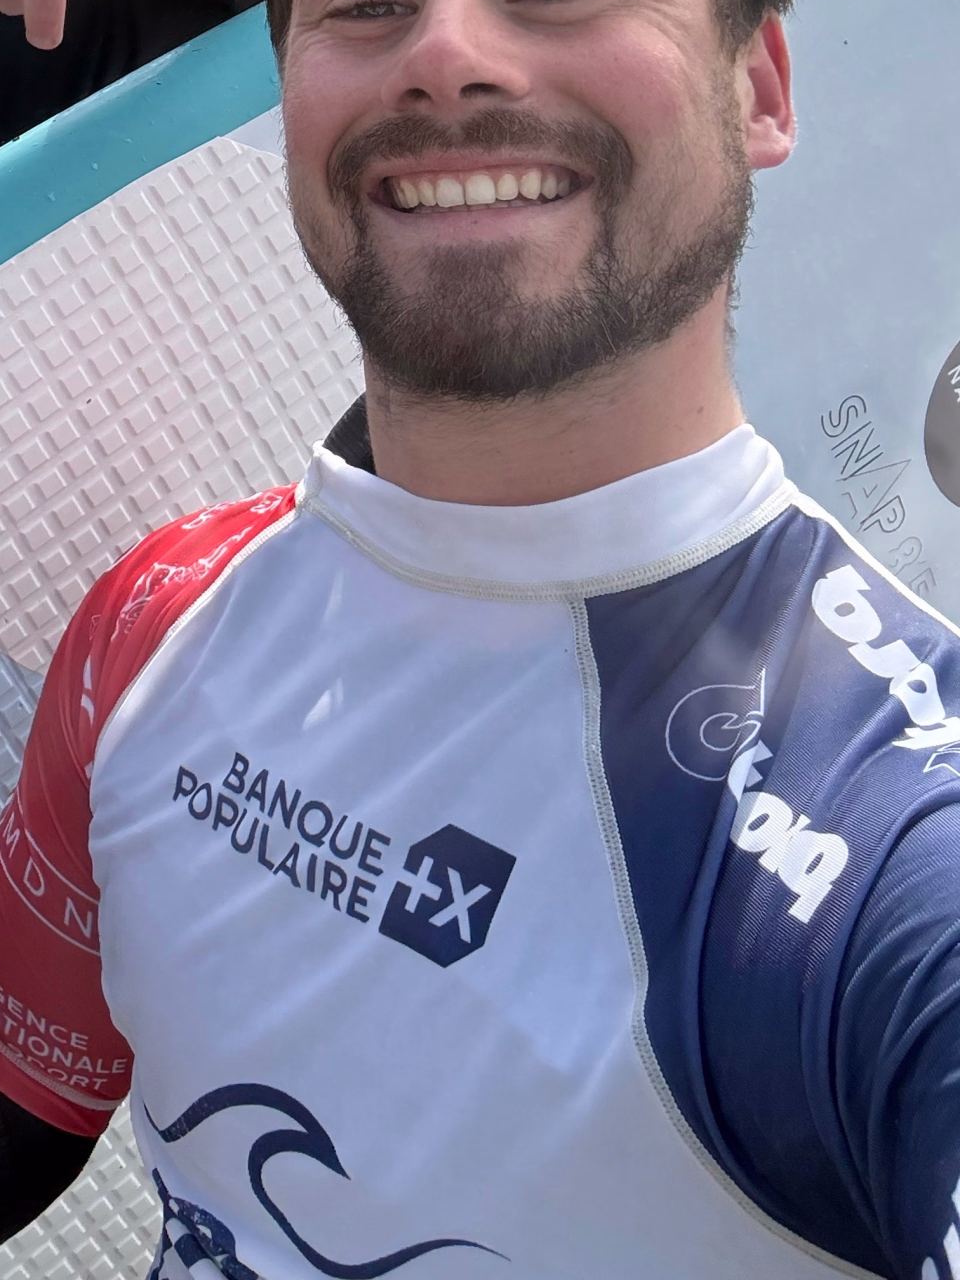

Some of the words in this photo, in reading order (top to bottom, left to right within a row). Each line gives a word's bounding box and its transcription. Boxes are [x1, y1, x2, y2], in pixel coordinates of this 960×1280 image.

[821, 394, 911, 533] SNAP
[172, 765, 377, 924] POPULAIRE
[222, 751, 391, 877] BANQUE
